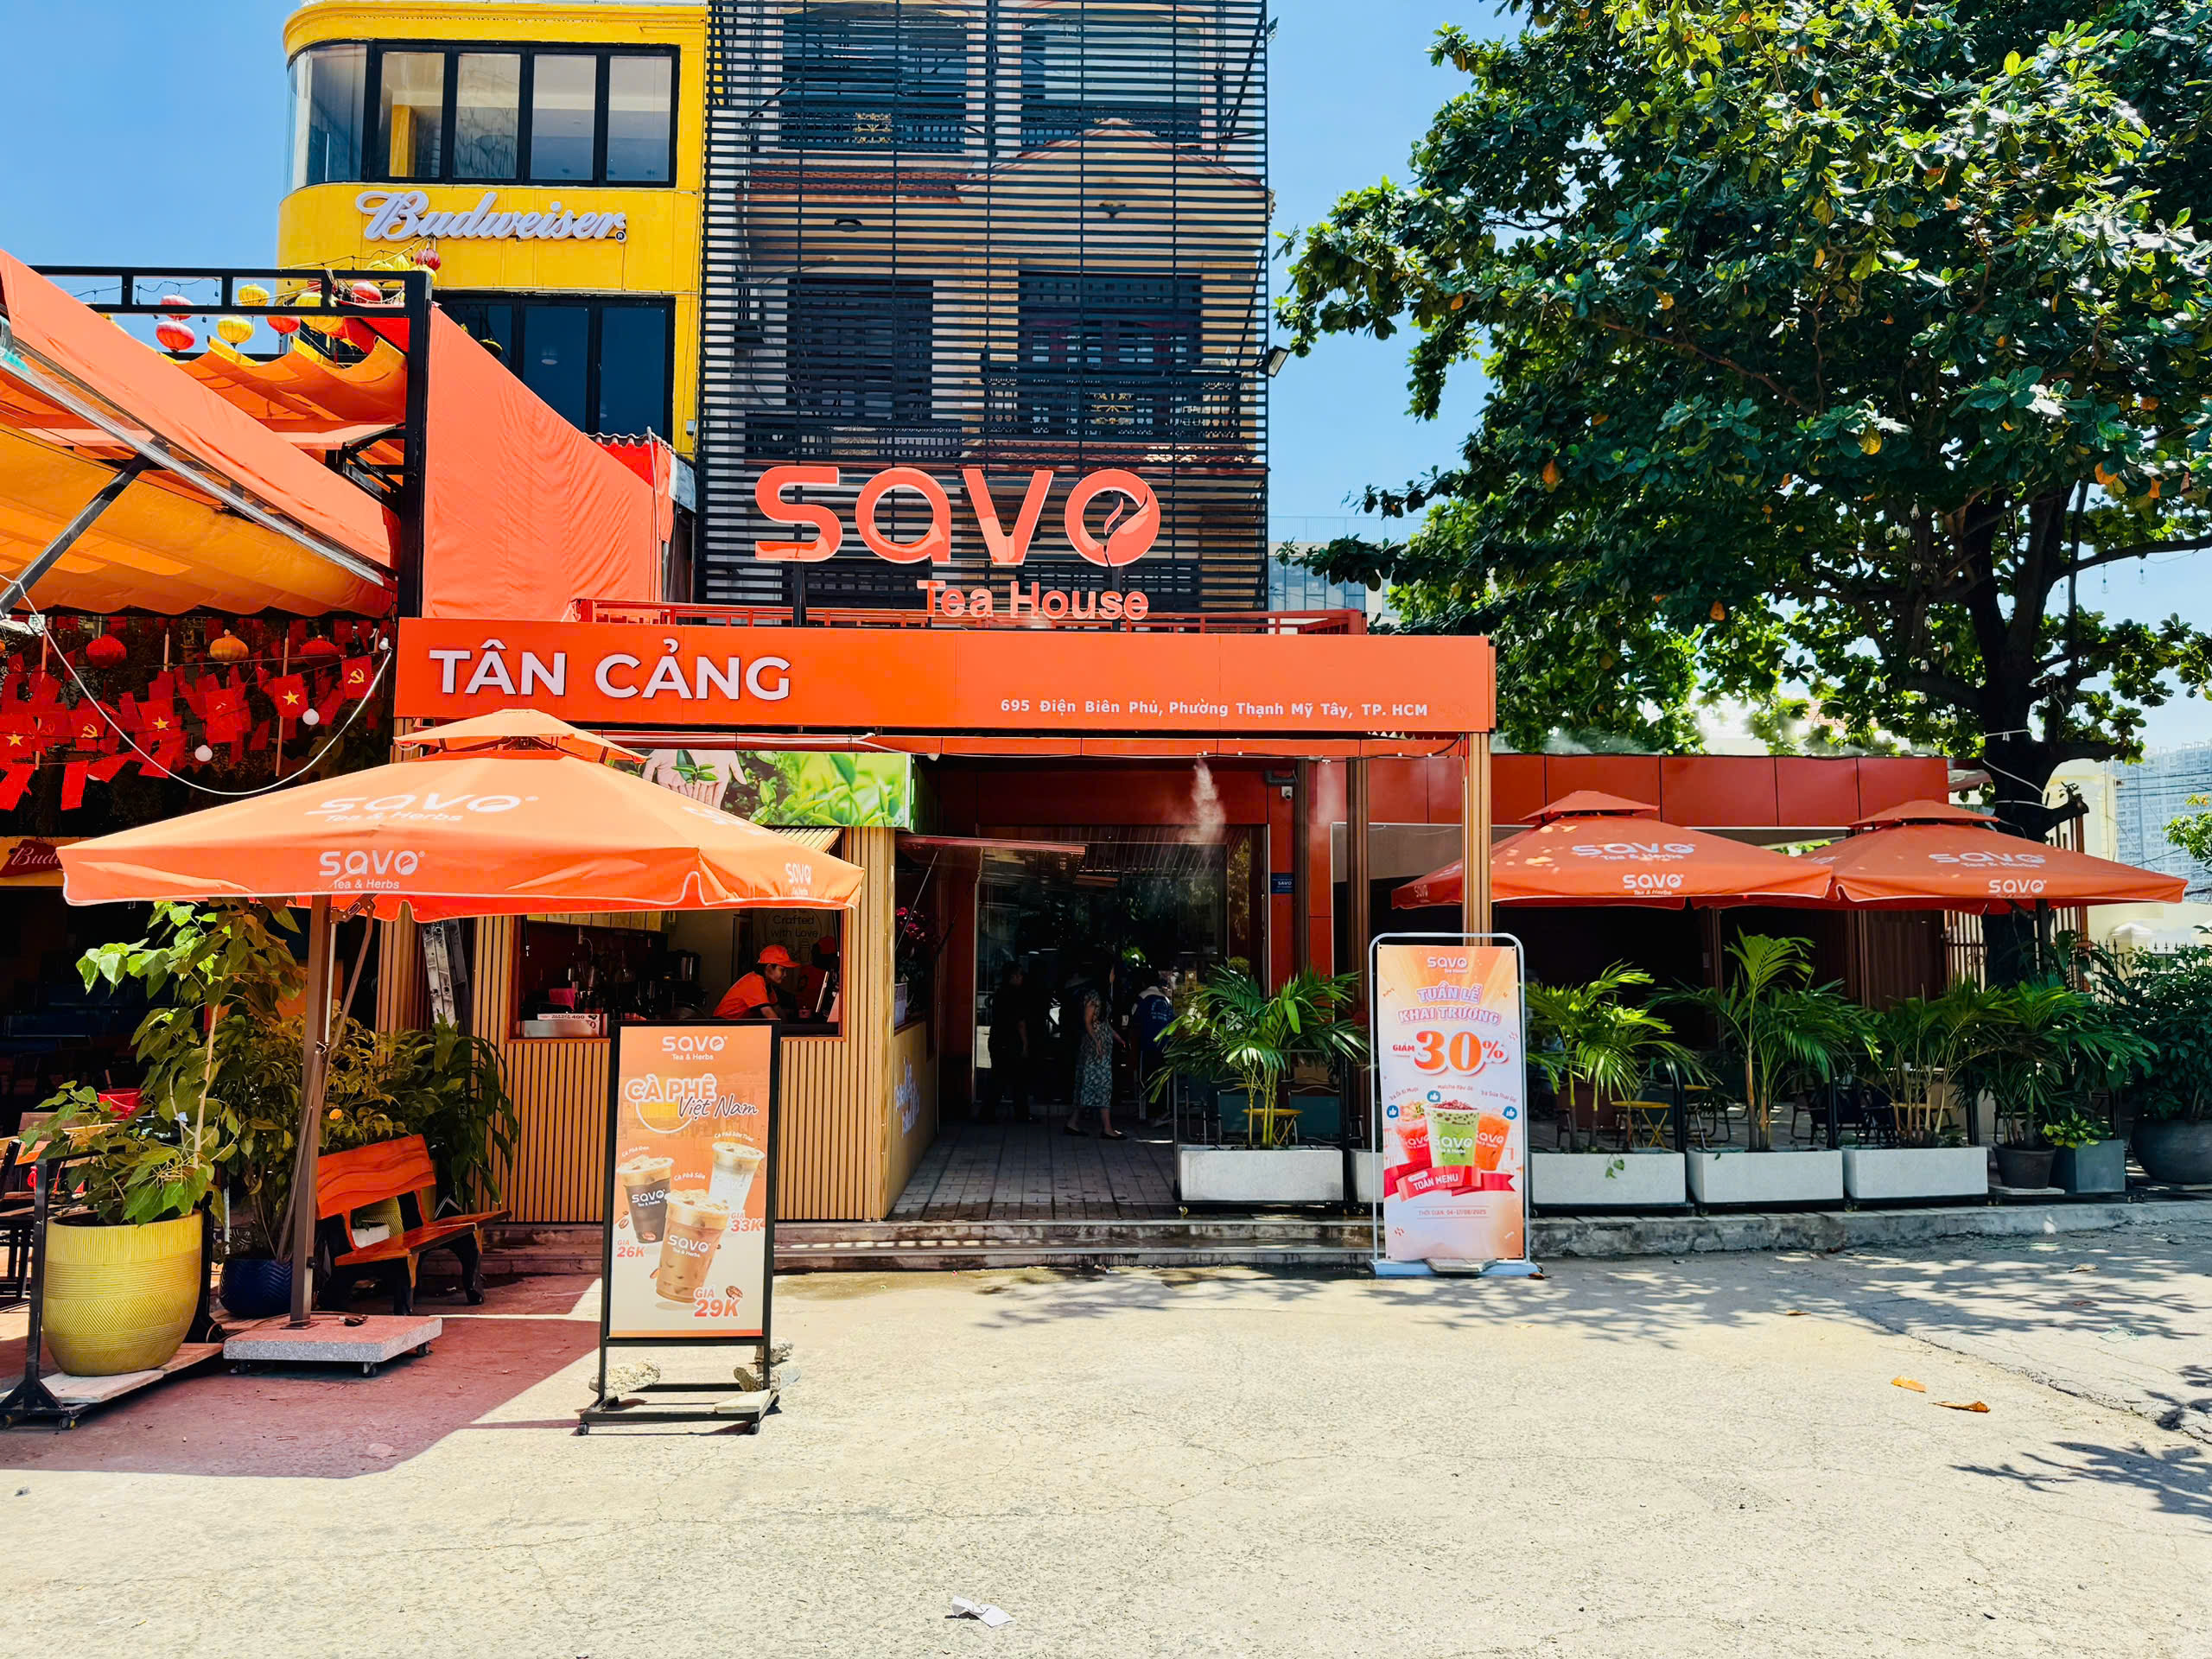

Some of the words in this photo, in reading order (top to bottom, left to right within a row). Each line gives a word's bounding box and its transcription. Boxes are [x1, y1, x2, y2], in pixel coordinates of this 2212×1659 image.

[356, 190, 626, 242] Budweiser
[917, 580, 993, 618] Tea
[1010, 581, 1148, 620] House
[429, 639, 566, 696] TÂN
[594, 638, 791, 701] CẢNG
[1001, 699, 1030, 712] 695
[1039, 699, 1076, 715] Điện
[1085, 700, 1120, 713] Biên
[1129, 700, 1163, 717] Phủ,
[1169, 698, 1228, 717] Phường
[1236, 702, 1283, 717] Thạnh
[1291, 702, 1313, 717] Mỹ
[1320, 702, 1353, 719] Tây,
[1362, 703, 1386, 715] TP.
[1392, 703, 1427, 716] HCM
[391, 810, 463, 821] Herbs
[334, 880, 351, 889] Tea
[355, 880, 362, 889] &
[366, 880, 399, 889] Herbs
[773, 915, 814, 925] Crafted
[771, 928, 791, 938] with
[795, 928, 818, 938] Love
[1398, 1007, 1436, 1024] KHAI
[1414, 1030, 1504, 1071] 30%
[625, 1074, 664, 1102] CÀ
[666, 1073, 717, 1102] PHÊ
[678, 1095, 710, 1121] Việt
[714, 1094, 759, 1117] Nam
[1435, 1173, 1459, 1185] MENU
[731, 1219, 761, 1231] 33K
[617, 1246, 644, 1257] 26K
[695, 1300, 740, 1317] 29K
